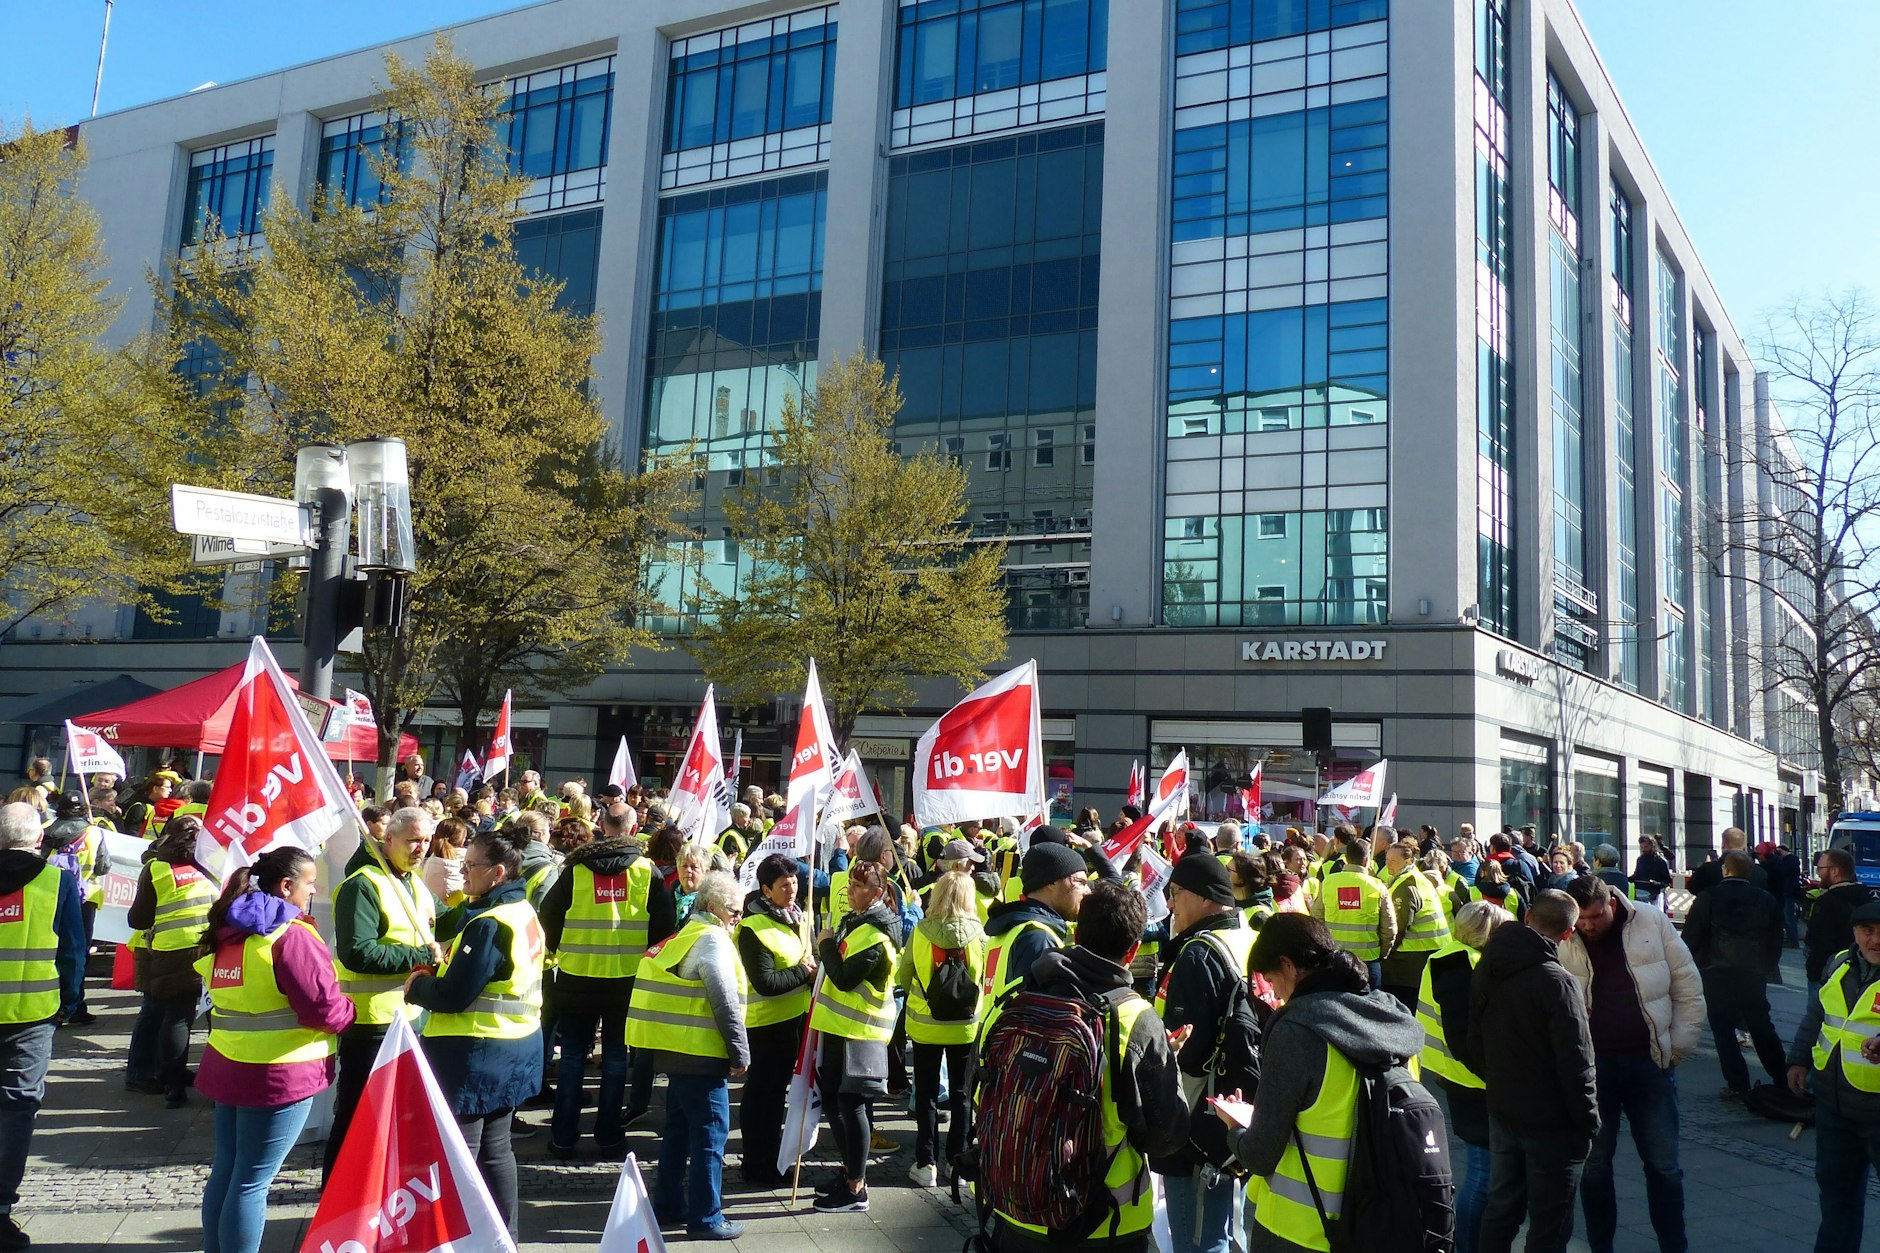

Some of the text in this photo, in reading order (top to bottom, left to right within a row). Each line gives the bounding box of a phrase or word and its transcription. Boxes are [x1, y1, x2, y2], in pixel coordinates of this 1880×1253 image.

[196, 499, 294, 532] Pestalozzistraße
[202, 536, 234, 553] Wilme
[1242, 640, 1387, 660] KARSTADT
[860, 740, 899, 758] Crêperie
[213, 966, 241, 980] ver.di
[1022, 1050, 1048, 1064] BURTON
